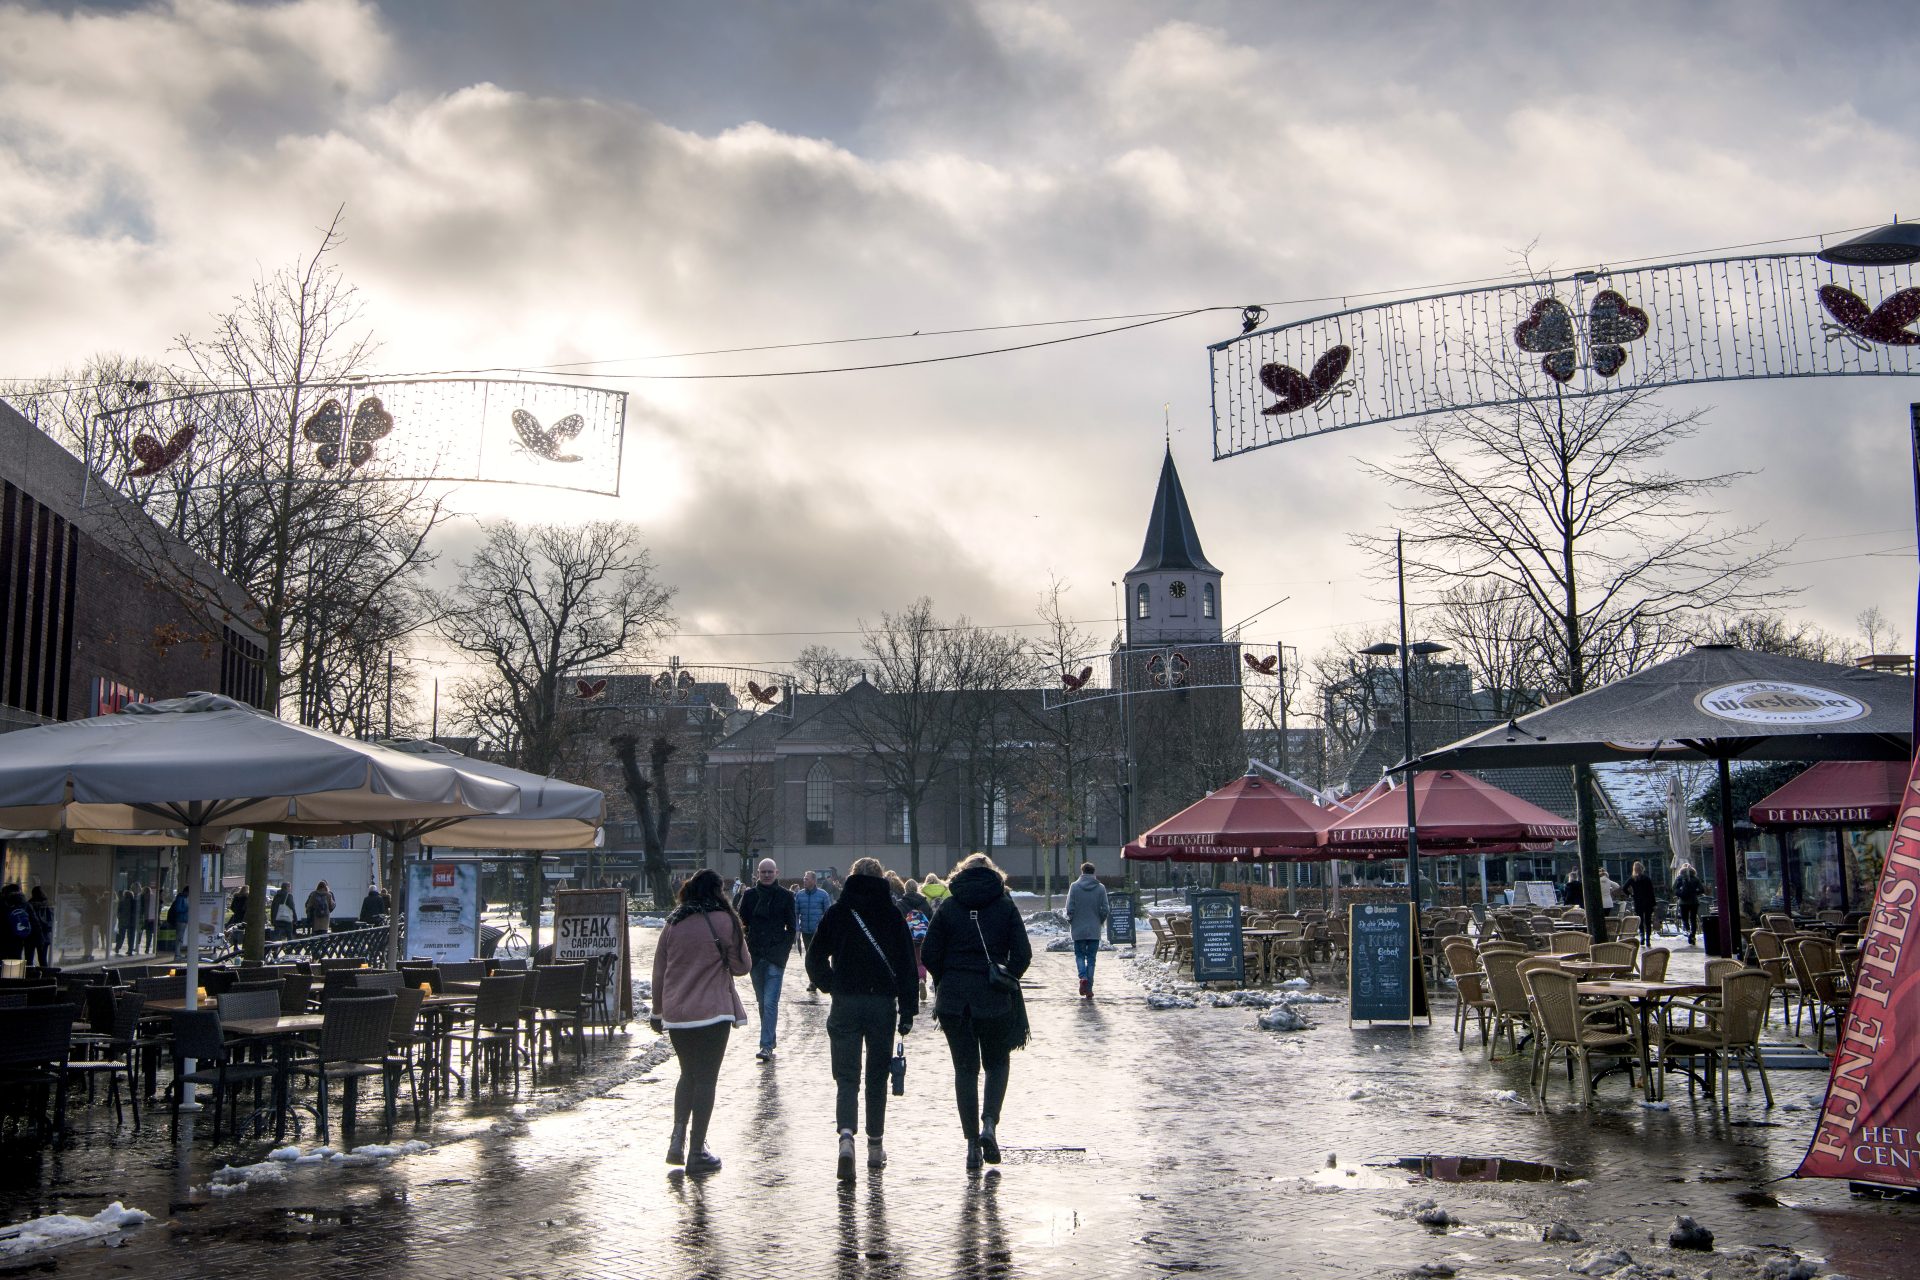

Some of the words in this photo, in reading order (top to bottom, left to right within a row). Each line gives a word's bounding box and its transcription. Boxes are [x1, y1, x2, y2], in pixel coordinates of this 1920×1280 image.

[1709, 695, 1853, 711] Warsteiner
[1768, 809, 1787, 821] DE
[1792, 808, 1872, 821] BRASSERIE
[1152, 835, 1165, 846] DE
[1167, 833, 1216, 846] BRASSERIE
[1333, 830, 1346, 842] DE
[1351, 827, 1409, 840] BRASSERIE
[1199, 846, 1248, 854] BRASSERIE
[435, 873, 452, 882] SILK
[1373, 906, 1398, 914] Warsteiner
[561, 917, 611, 938] STEAK
[571, 937, 617, 949] CARPACCIO
[560, 950, 586, 958] SOUP
[1811, 1011, 1886, 1161] FIJNE
[1854, 779, 1920, 1009] FEESTD
[1862, 1127, 1908, 1145] HET
